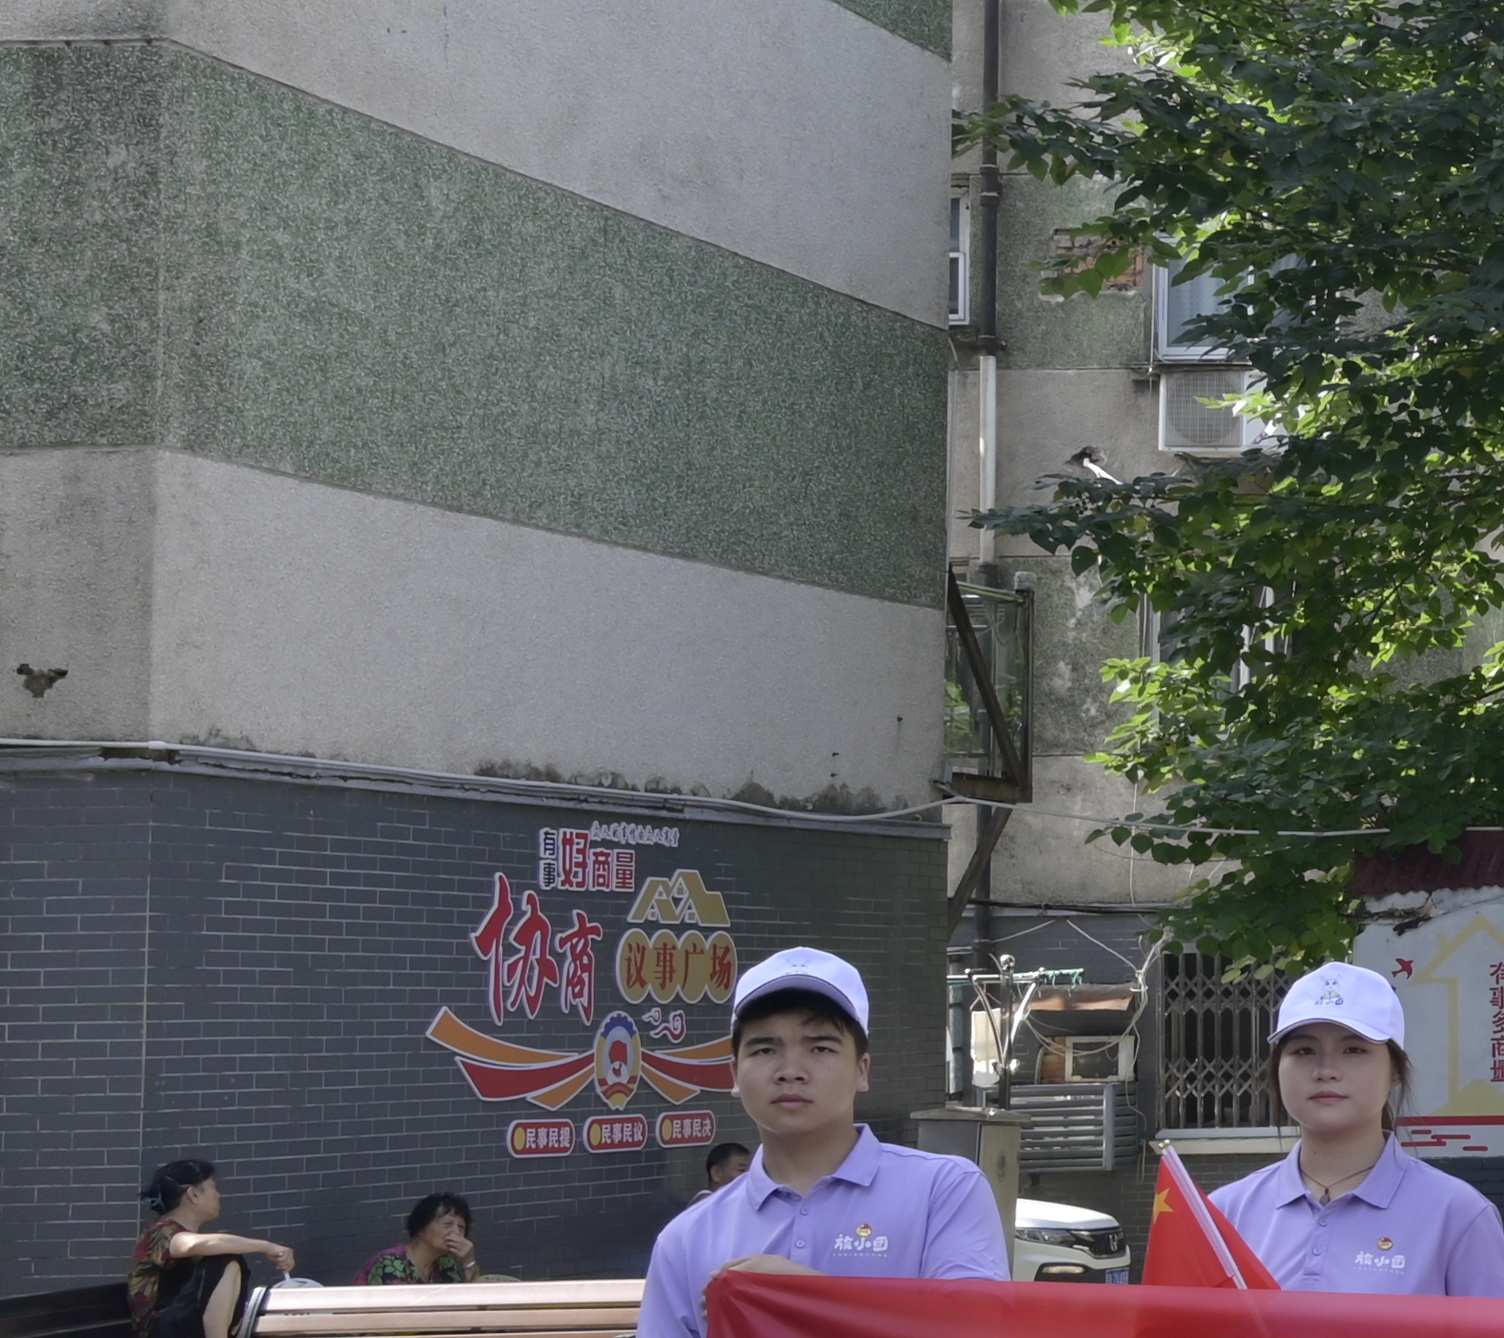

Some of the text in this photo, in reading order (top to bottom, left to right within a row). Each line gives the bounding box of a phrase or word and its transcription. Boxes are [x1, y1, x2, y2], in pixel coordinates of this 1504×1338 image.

[625, 941, 733, 992] 议事广场
[525, 1126, 571, 1149] 民事民提
[600, 1122, 643, 1144] 民事民议
[672, 1117, 712, 1140] 民事民决
